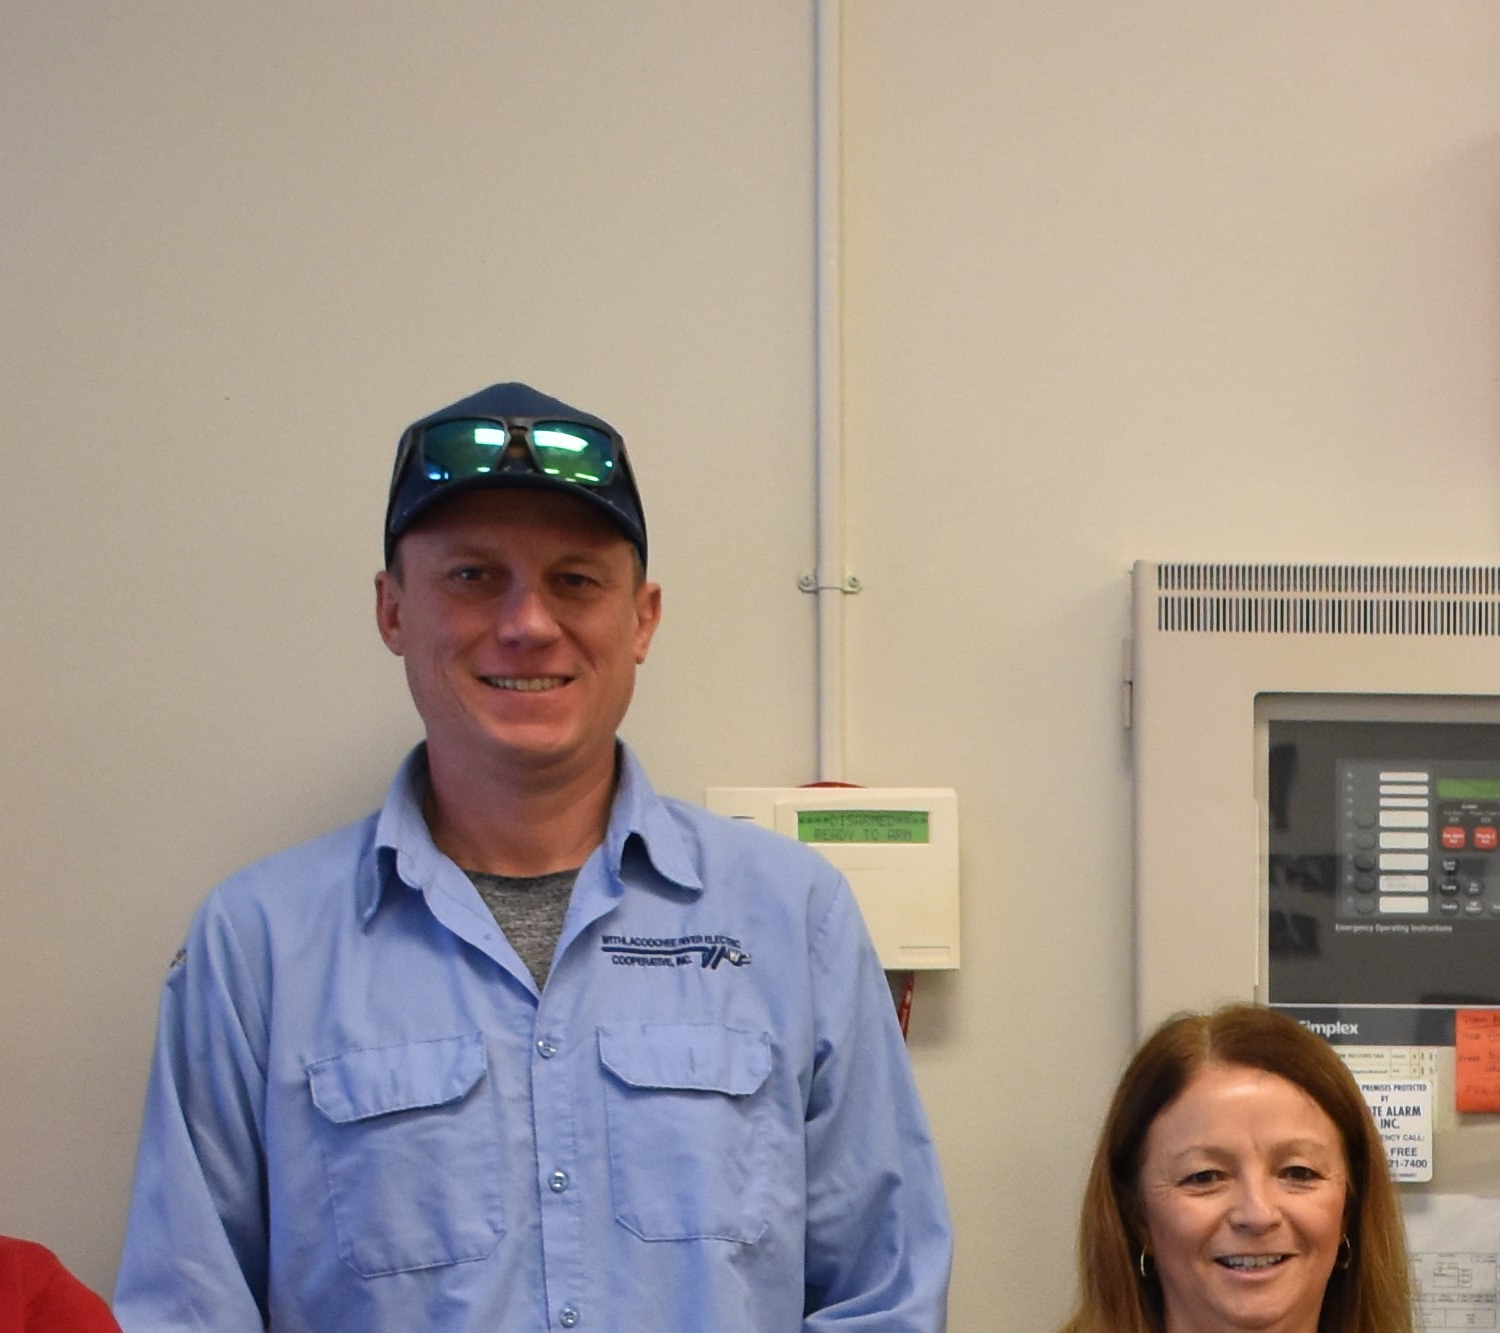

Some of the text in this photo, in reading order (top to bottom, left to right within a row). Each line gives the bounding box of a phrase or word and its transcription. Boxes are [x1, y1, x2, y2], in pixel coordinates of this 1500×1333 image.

[814, 829, 912, 841] READY TO ARM
[1335, 923, 1453, 933] Emergency Operating Instructions
[678, 935, 702, 946] RIVER
[704, 935, 741, 949] ELECTRIC
[1362, 1083, 1427, 1092] PREMISES PROTECTED
[1386, 1106, 1421, 1117] ALARM
[1380, 1118, 1400, 1129] INC.
[1390, 1147, 1418, 1157] FREE
